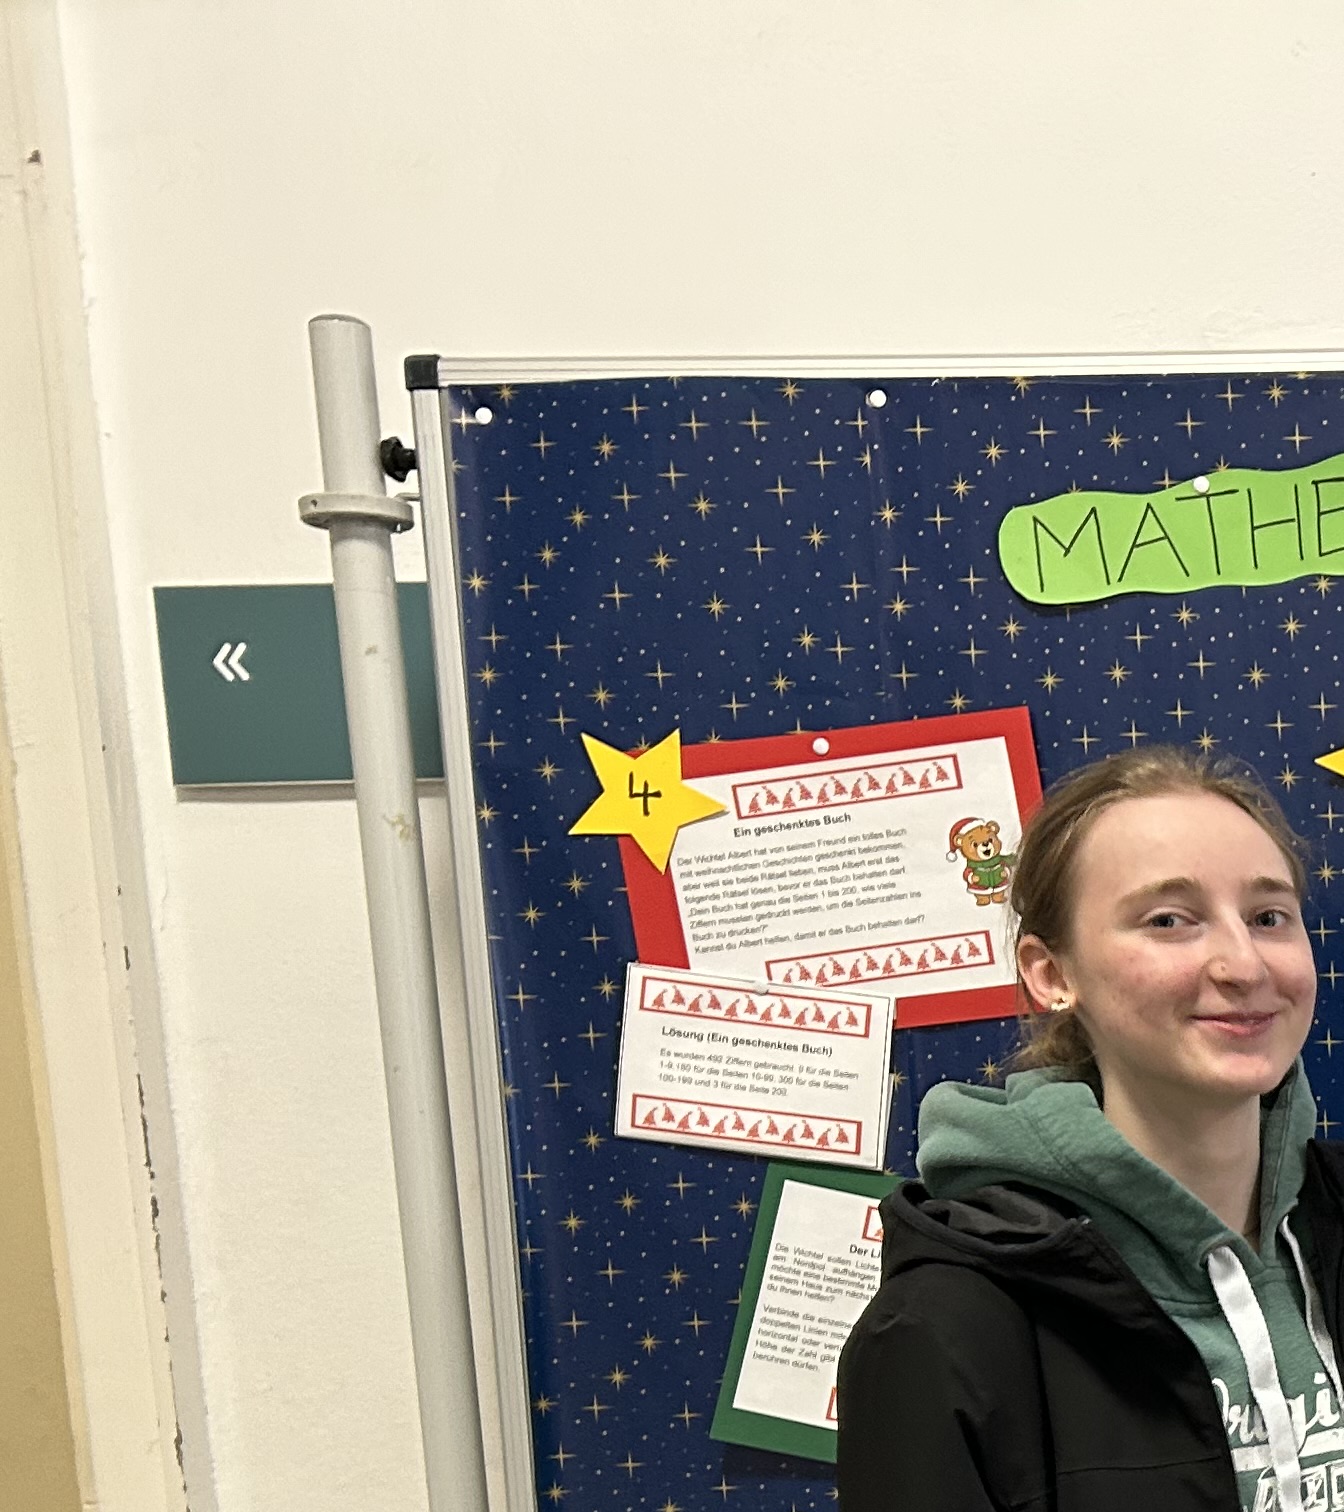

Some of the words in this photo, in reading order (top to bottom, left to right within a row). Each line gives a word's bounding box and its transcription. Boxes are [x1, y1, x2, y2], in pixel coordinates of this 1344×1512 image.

[628, 771, 662, 816] 4
[733, 827, 752, 838] Ein
[753, 819, 821, 836] geschenktes
[823, 813, 852, 825] Buch
[661, 1026, 704, 1042] Lösung
[707, 1032, 729, 1043] (Ein
[731, 1037, 799, 1052] geschenktes
[801, 1043, 833, 1058] Buch)
[850, 1244, 868, 1256] Der
